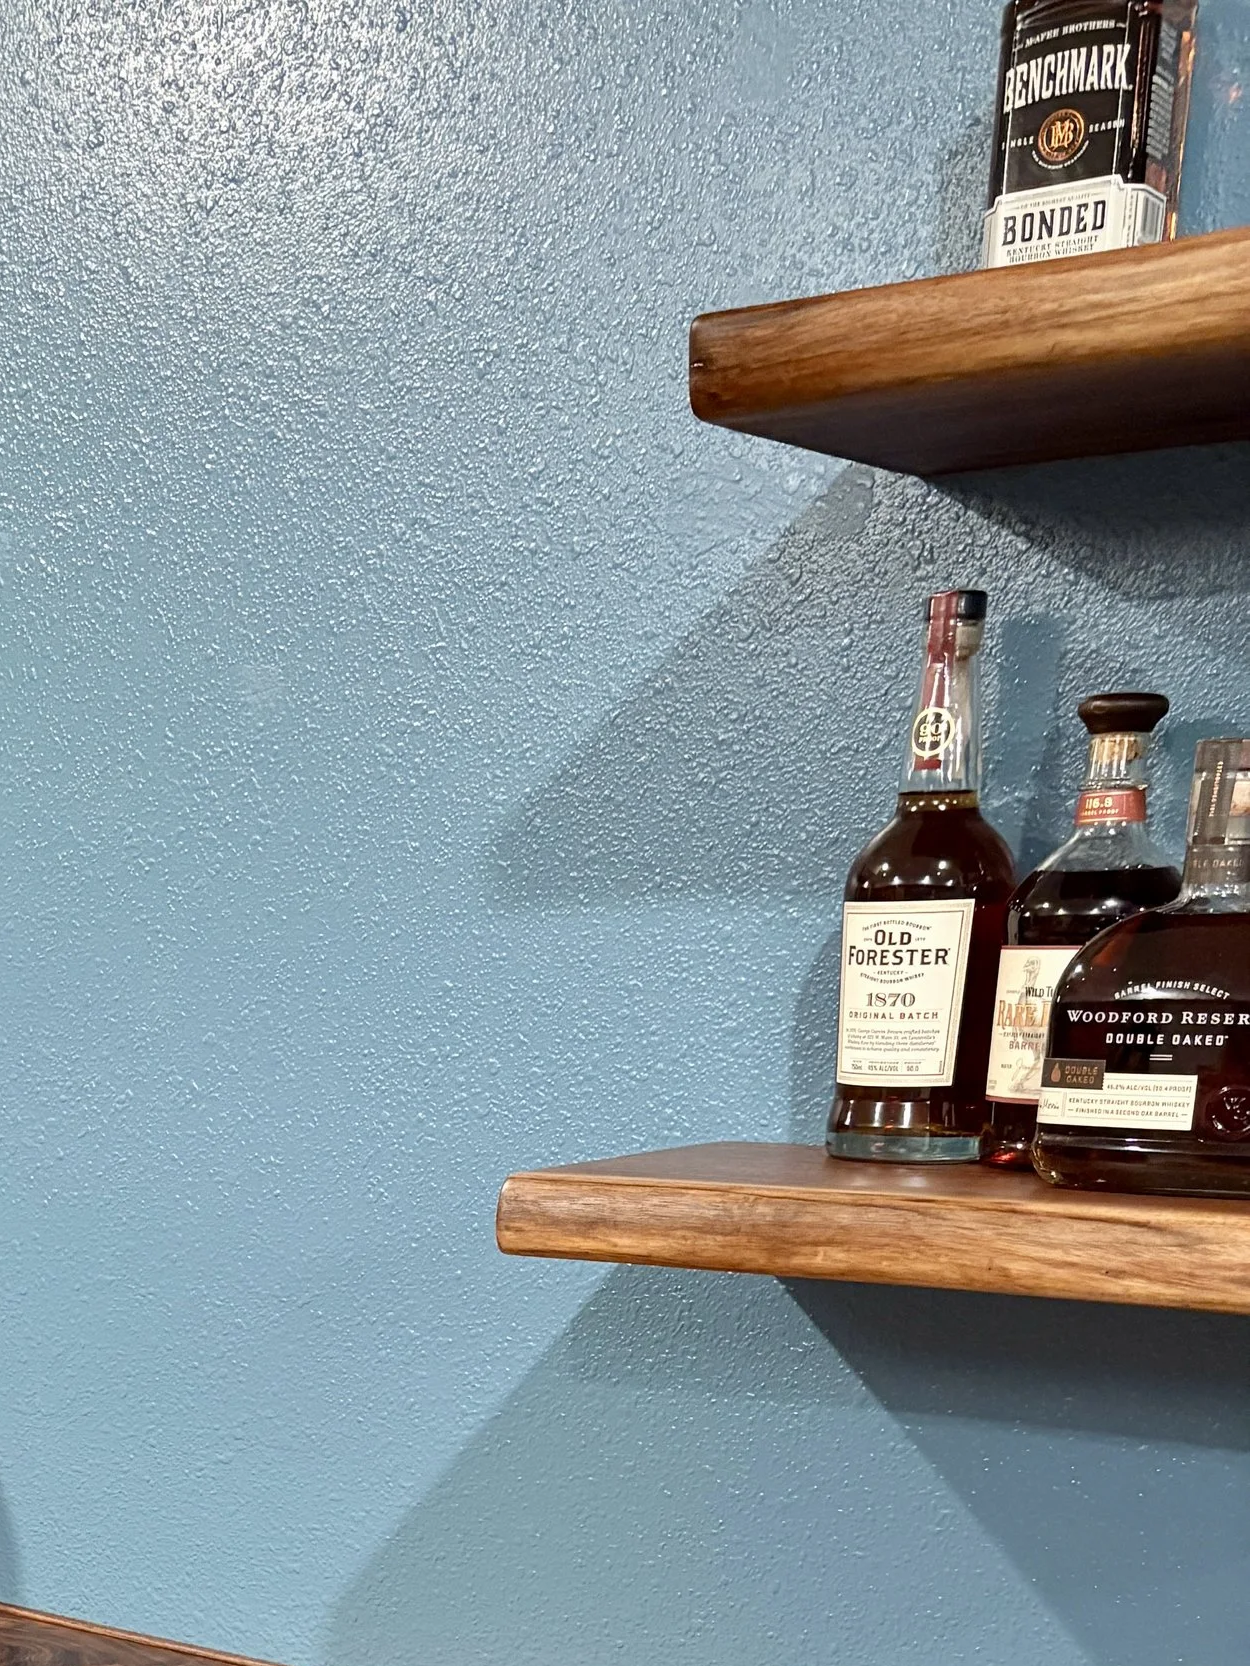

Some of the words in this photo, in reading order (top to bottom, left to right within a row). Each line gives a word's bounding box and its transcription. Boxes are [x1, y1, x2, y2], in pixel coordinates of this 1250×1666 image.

[1062, 19, 1116, 36] BROTHERS
[1003, 43, 1132, 115] BENCHMARK
[1002, 135, 1035, 151] SNGLE
[1002, 200, 1107, 247] BONDED
[1006, 243, 1052, 257] KENTUCKY
[1054, 234, 1099, 250] STRAIGHT
[1008, 249, 1052, 264] BOURBON
[1085, 796, 1113, 809] 116.8
[869, 920, 882, 930] FIRST
[905, 920, 931, 931] BOURBON
[874, 929, 912, 946] OLD
[848, 945, 949, 966] FORESTER
[860, 972, 879, 983] STRAIGHT
[1025, 986, 1045, 998] WILD
[1114, 982, 1151, 1000] BARREL
[1155, 980, 1191, 990] FINISH
[1192, 982, 1231, 1000] SELECT
[866, 992, 916, 1007] 1870
[848, 1011, 894, 1020] ORIGINAL
[899, 1011, 939, 1020] BATCH
[997, 1000, 1039, 1030] RARE
[1066, 1009, 1173, 1025] WOODFORD
[1105, 1032, 1165, 1045] DOUBLE
[1171, 1034, 1224, 1046] OAKED
[1064, 1065, 1099, 1076] DOUBLE
[1066, 1076, 1096, 1085] OAKED
[1068, 1097, 1098, 1105] KENTUCKY
[1099, 1098, 1129, 1106] STRAIGHT
[1130, 1099, 1160, 1107] BOURBON
[1075, 1107, 1102, 1115] FINISHED
[1140, 1109, 1153, 1117] OAK
[1154, 1110, 1179, 1118] BARREL
